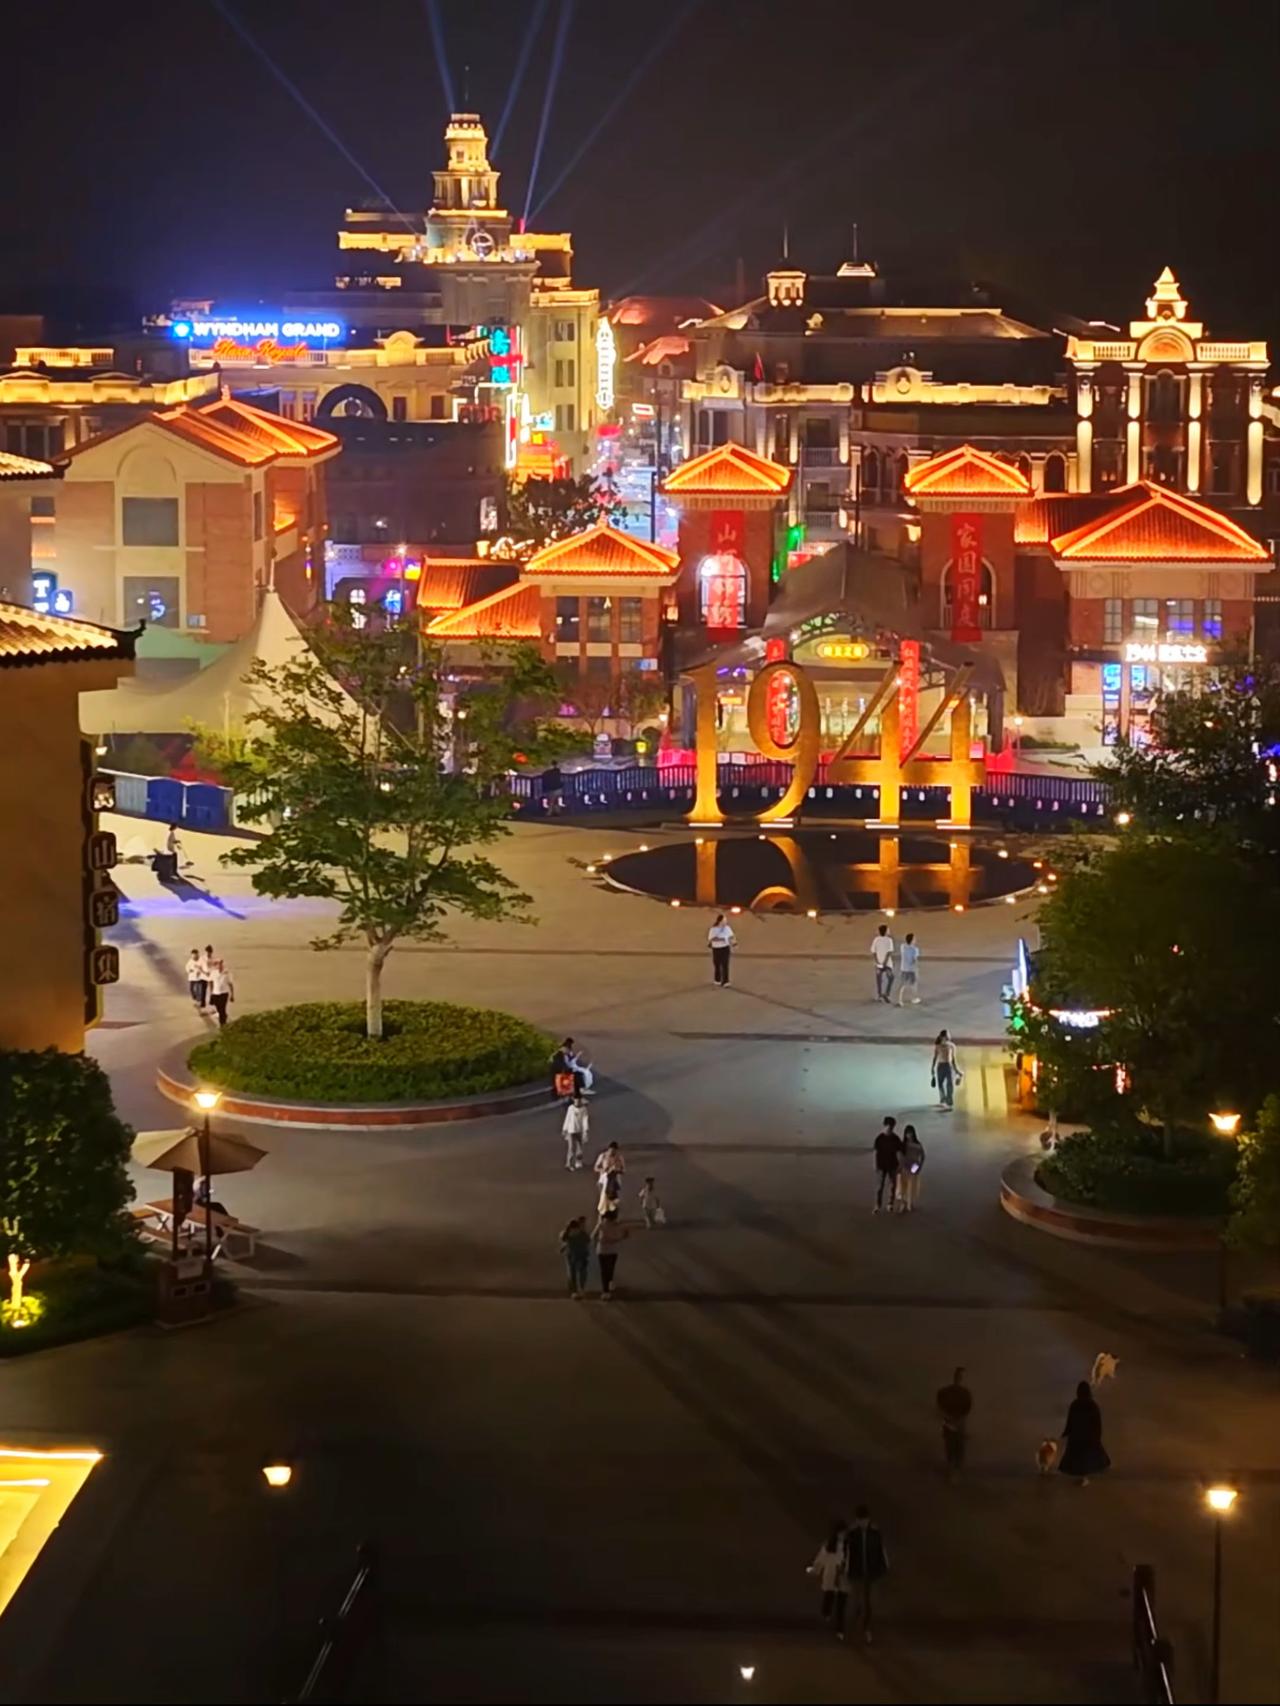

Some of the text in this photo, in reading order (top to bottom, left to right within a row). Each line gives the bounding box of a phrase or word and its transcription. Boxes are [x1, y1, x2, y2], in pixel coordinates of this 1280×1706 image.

[194, 322, 340, 338] WYNDHAM GRAND
[680, 660, 986, 827] 1944
